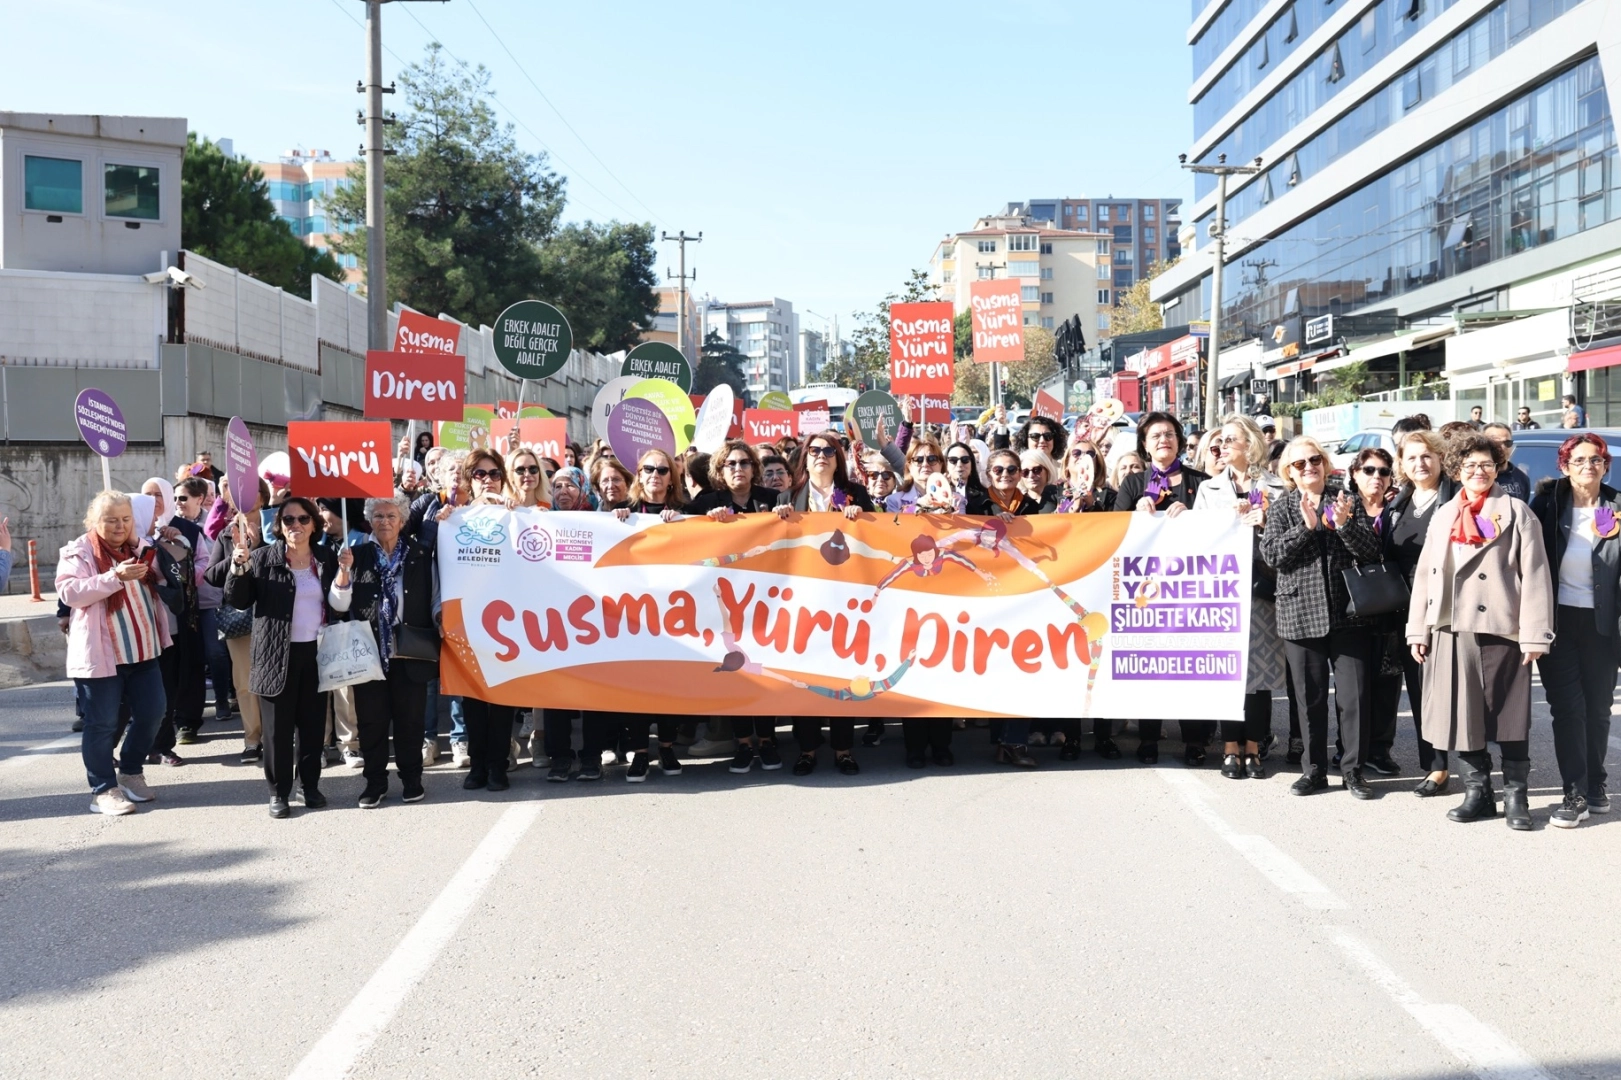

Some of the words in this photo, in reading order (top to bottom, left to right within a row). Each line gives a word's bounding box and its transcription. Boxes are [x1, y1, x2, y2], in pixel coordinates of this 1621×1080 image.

[972, 293, 1020, 312] Susma
[504, 319, 530, 334] ERKEK
[531, 322, 561, 337] ADALET
[892, 318, 952, 338] Susma
[977, 308, 1018, 330] Yürü
[399, 326, 454, 354] Susma
[504, 333, 527, 350] DEĞİL
[528, 337, 558, 353] GERÇEK
[897, 335, 948, 358] Yürü
[975, 331, 1020, 349] Diren
[516, 351, 546, 367] ADALET
[630, 358, 653, 373] ERKEK
[654, 360, 682, 375] ADALET
[894, 359, 950, 379] Diren
[372, 370, 457, 402] Diren
[87, 397, 114, 416] İSTANBUL
[621, 403, 651, 417] ŞİDDETSİZ
[857, 406, 875, 418] ERKEK
[875, 404, 894, 416] ADALET
[909, 396, 950, 409] Susma
[621, 419, 653, 431] MÜCADELE
[625, 412, 646, 423] DÜNYA
[646, 416, 659, 426] İÇİN
[749, 419, 792, 438] Yürü
[860, 416, 876, 430] DEĞİL
[621, 426, 663, 441] DAYANIŞMAYA
[632, 436, 653, 446] DEVAM
[495, 435, 560, 458] Dren
[296, 440, 380, 478] Yürü
[556, 527, 593, 540] NİLÜFER
[458, 546, 501, 556] NİLÜFER
[1112, 557, 1120, 568] 25
[1123, 554, 1240, 576] KADINA
[1112, 570, 1120, 600] KASIM
[1122, 576, 1240, 600] YÖNELİK
[1114, 604, 1185, 632] ŞİDDETE
[1187, 607, 1237, 632] KARŞI
[900, 606, 1091, 675] Diren
[1115, 654, 1194, 675] MÜCADELE
[1195, 654, 1238, 675] GÜNÜ
